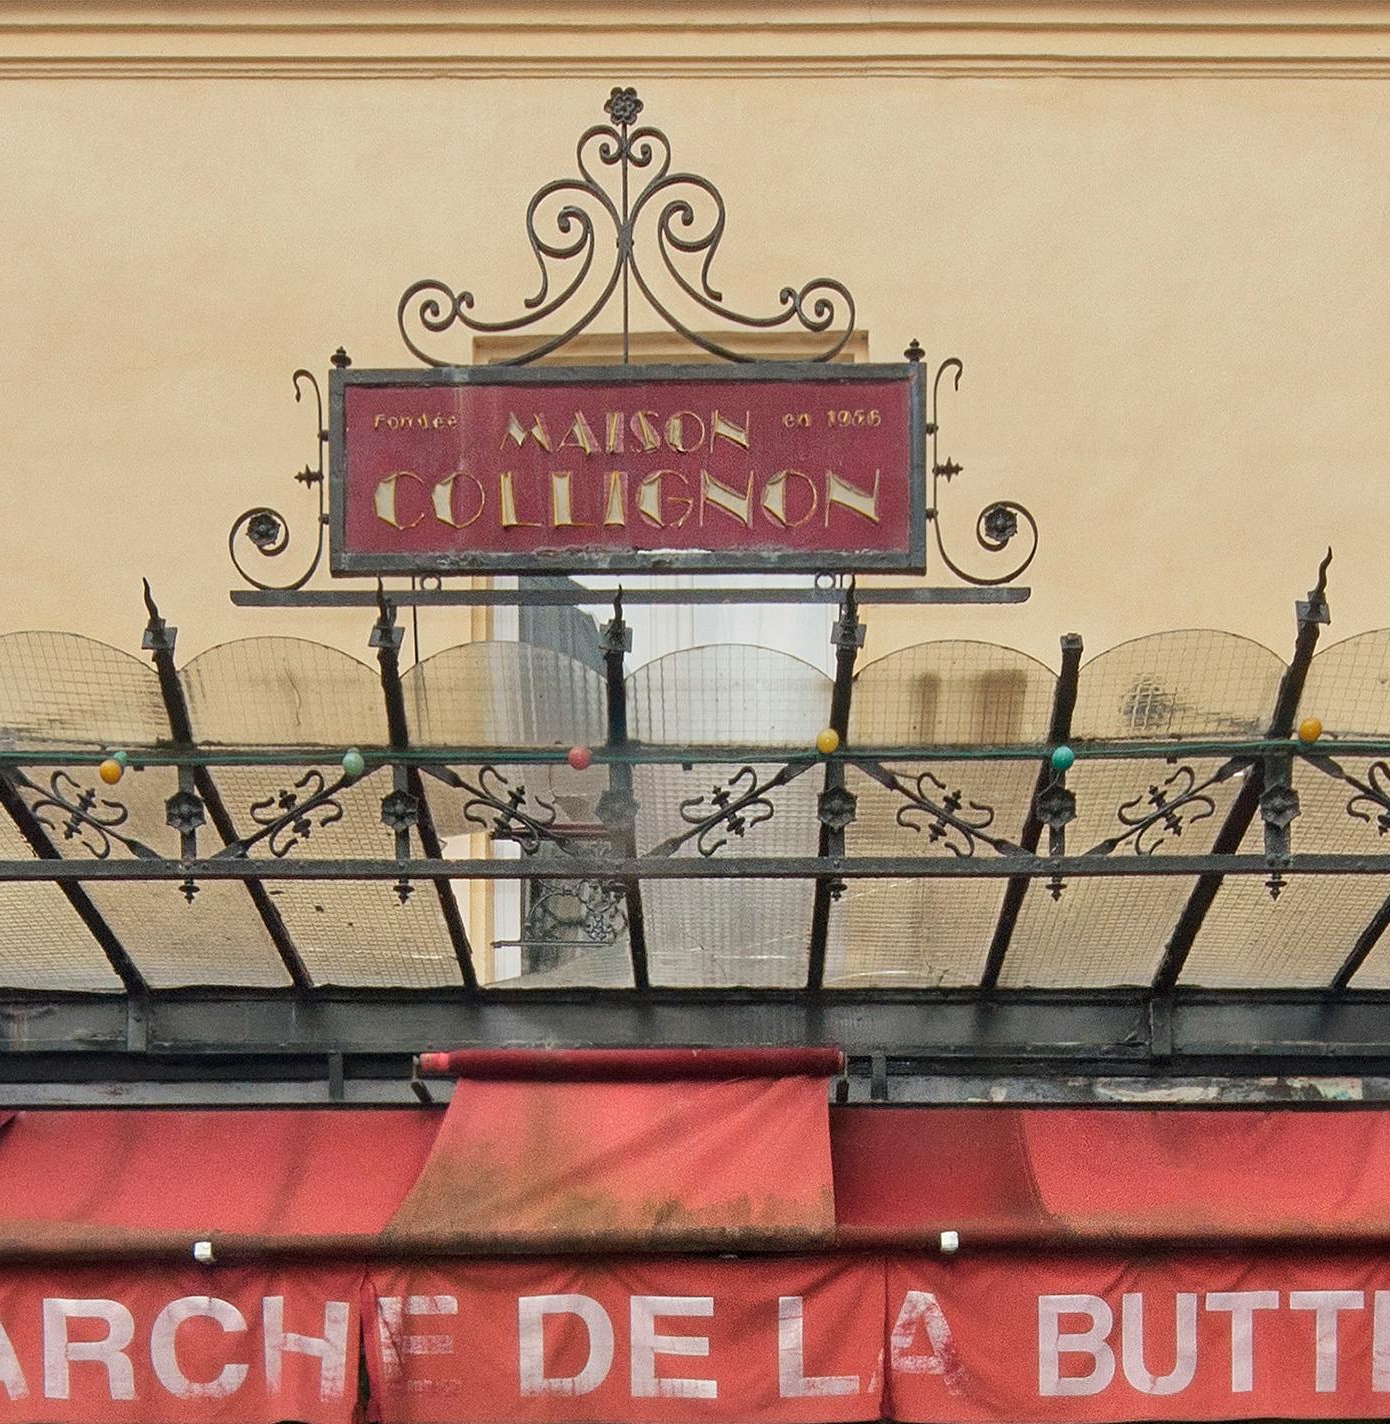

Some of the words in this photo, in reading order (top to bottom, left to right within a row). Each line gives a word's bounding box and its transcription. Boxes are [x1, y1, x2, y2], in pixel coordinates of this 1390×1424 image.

[501, 409, 750, 455] MAISON
[783, 412, 812, 429] en
[373, 469, 881, 529] COLLIGNON
[517, 1294, 718, 1400] DE
[778, 1289, 968, 1399] LA
